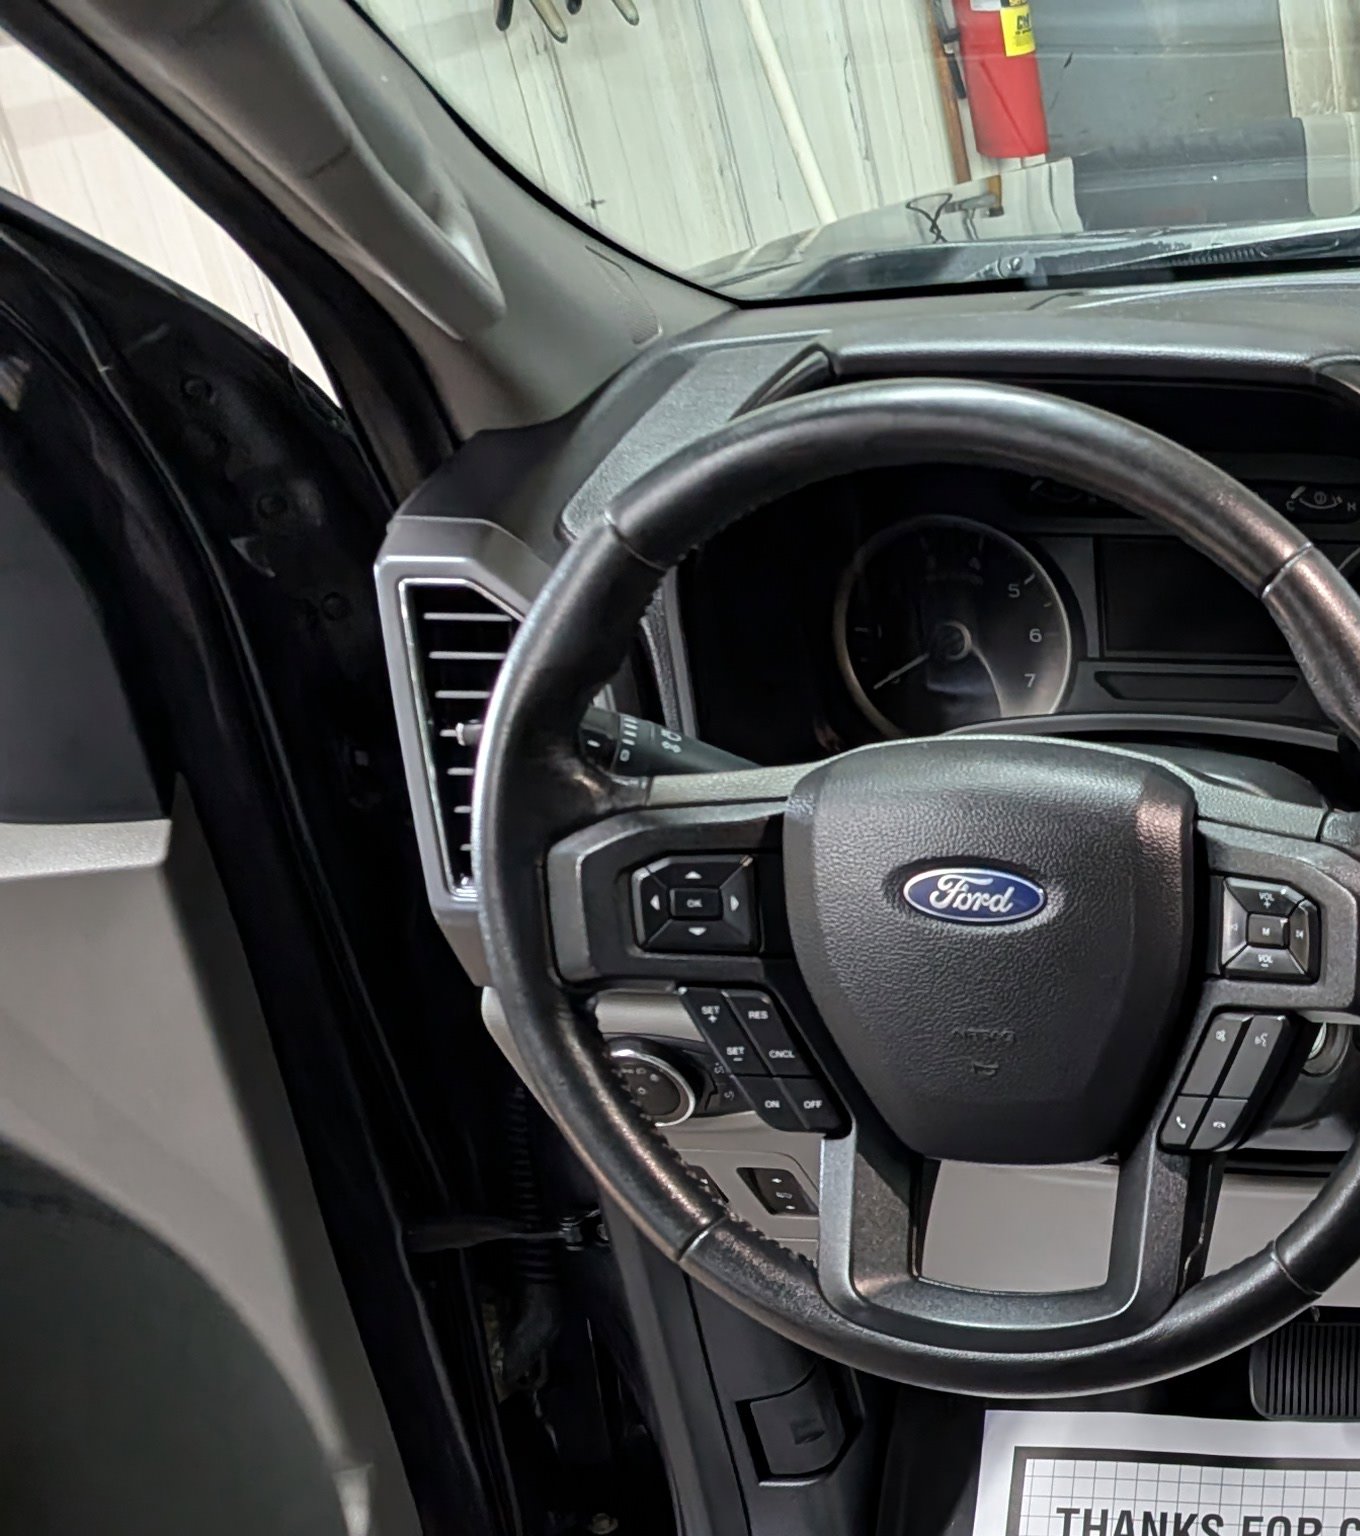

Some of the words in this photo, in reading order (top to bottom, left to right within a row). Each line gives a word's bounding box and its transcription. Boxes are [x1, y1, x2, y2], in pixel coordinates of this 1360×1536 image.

[1285, 501, 1295, 511] C
[1008, 583, 1021, 599] 5
[1029, 628, 1042, 643] 6
[1024, 672, 1036, 688] 7
[929, 874, 1015, 913] Ford
[701, 1005, 720, 1015] SET
[748, 1010, 769, 1020] RES
[726, 1046, 745, 1056] SET
[768, 1050, 796, 1059] CNCL
[764, 1100, 780, 1109] ON
[803, 1100, 823, 1109] OFF
